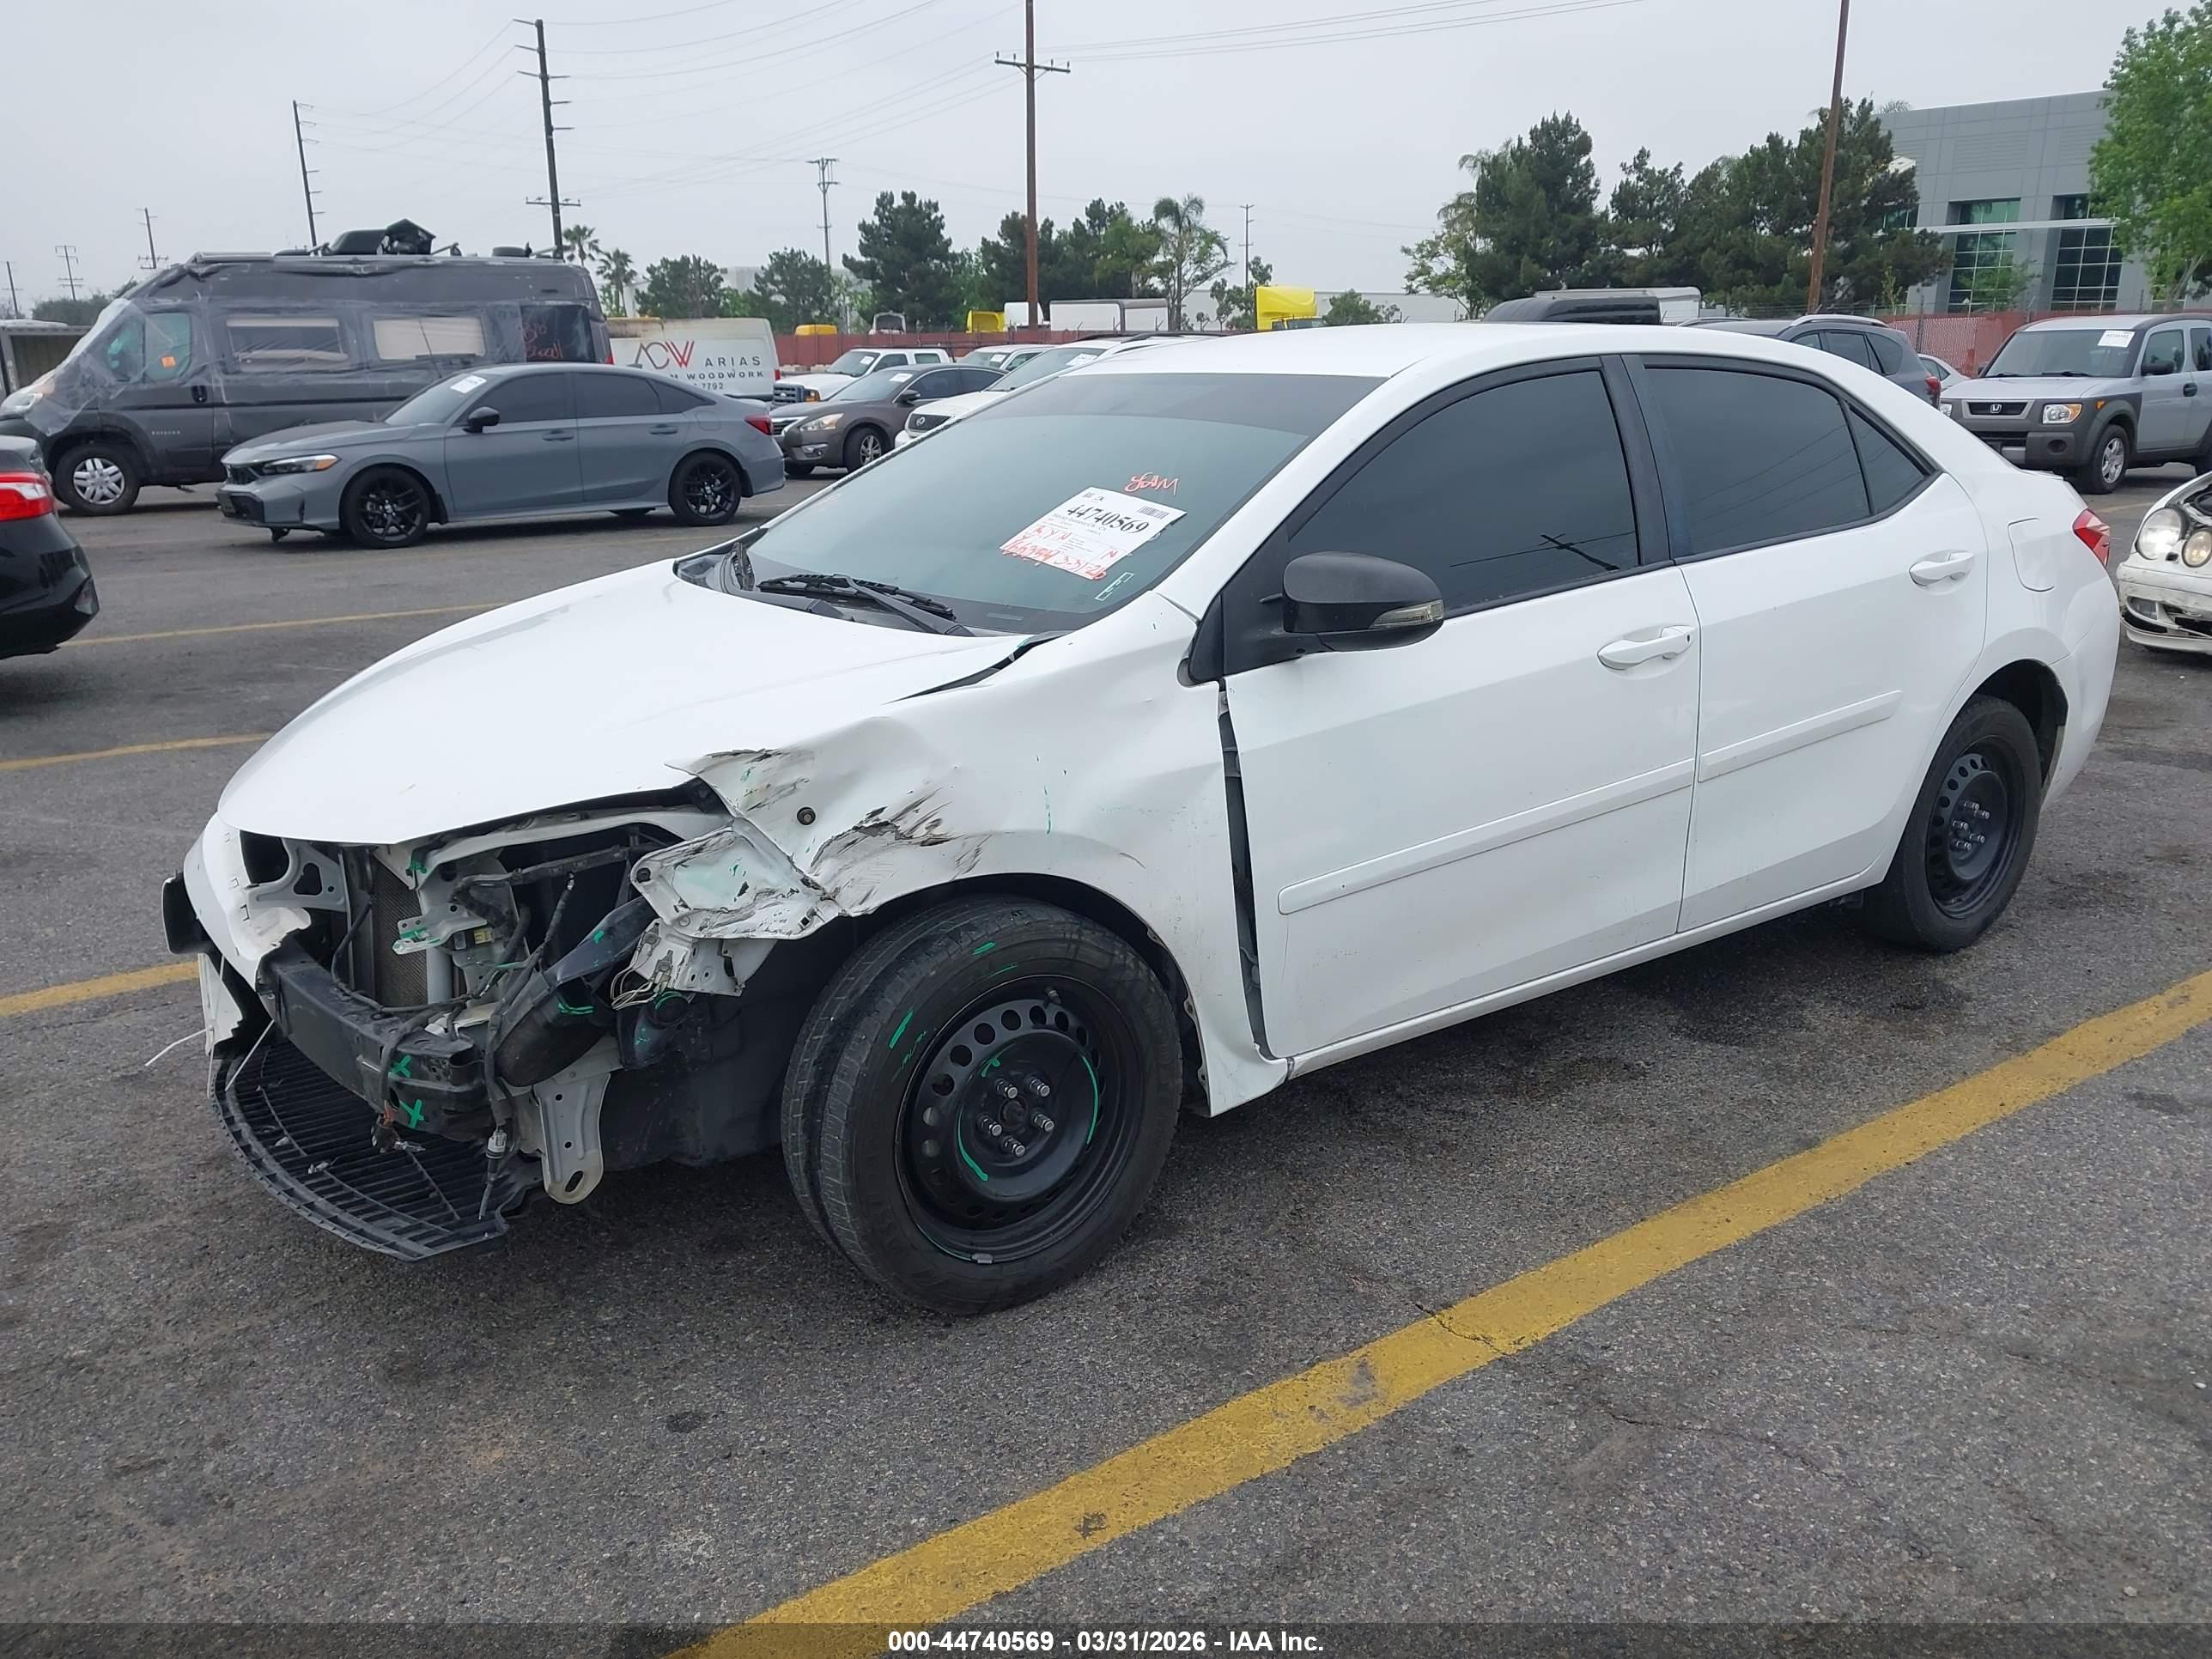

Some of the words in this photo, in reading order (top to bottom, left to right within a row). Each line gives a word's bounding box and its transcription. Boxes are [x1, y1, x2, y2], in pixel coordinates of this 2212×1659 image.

[704, 356, 761, 367] ARIAS
[686, 370, 763, 380] WOODWORK
[1067, 504, 1150, 534] 44740569
